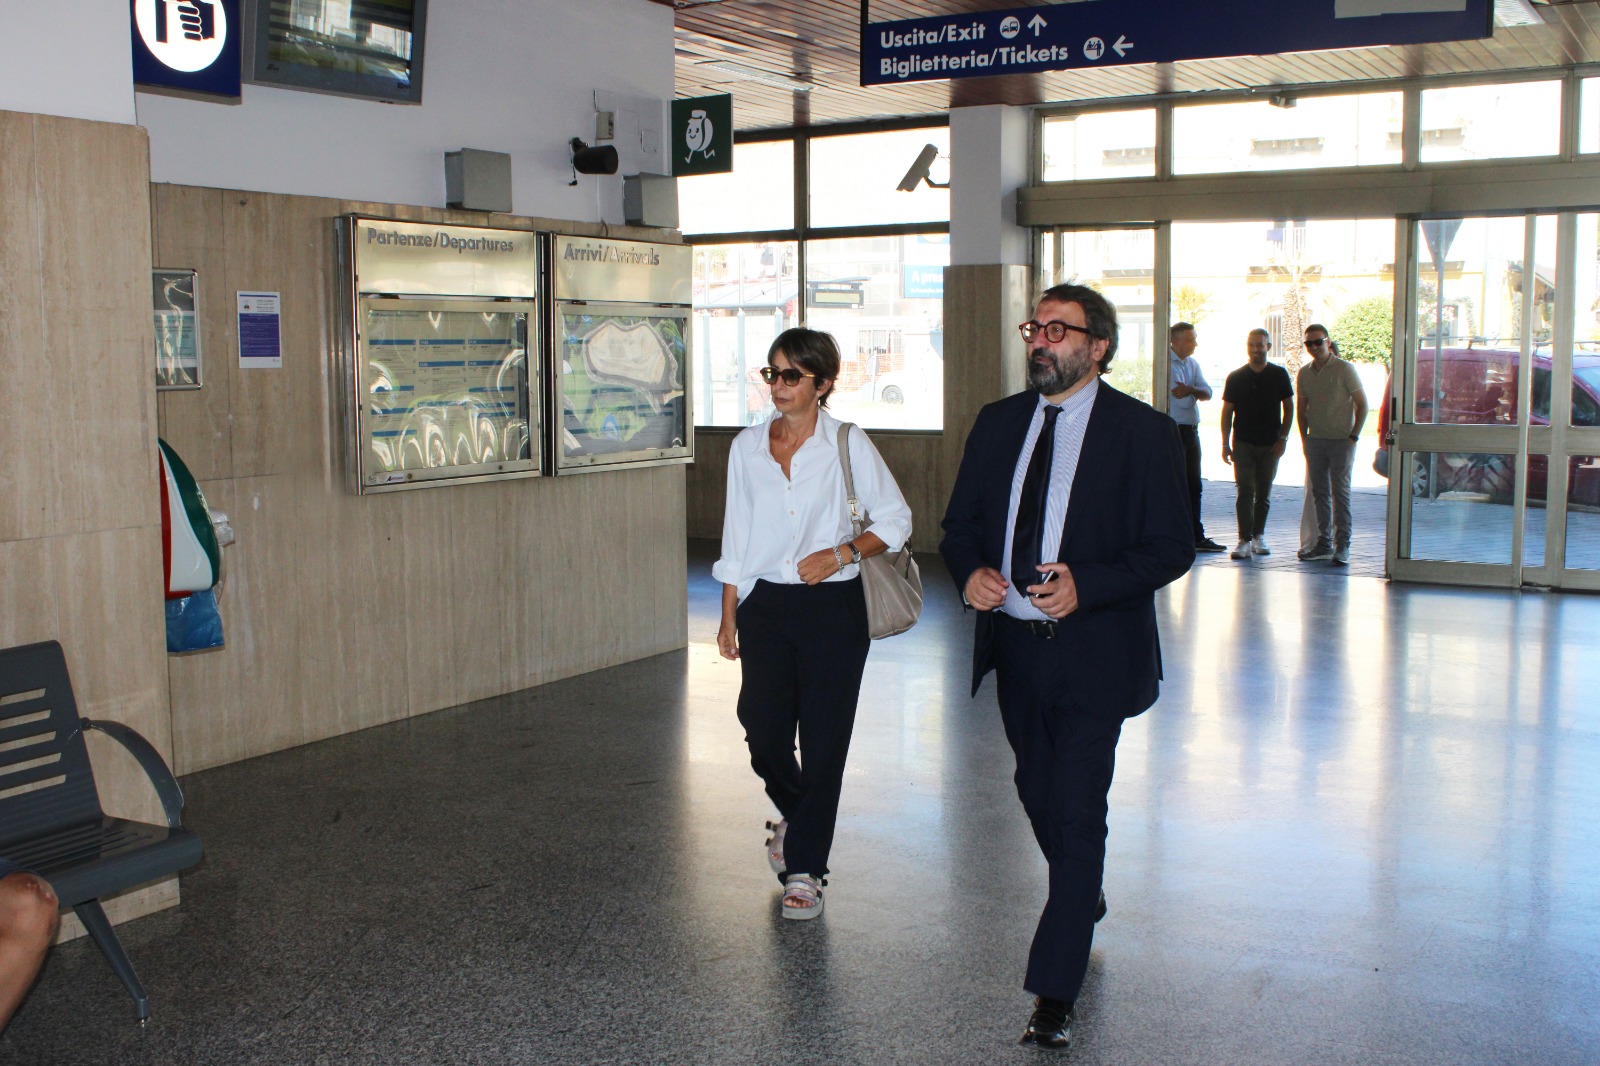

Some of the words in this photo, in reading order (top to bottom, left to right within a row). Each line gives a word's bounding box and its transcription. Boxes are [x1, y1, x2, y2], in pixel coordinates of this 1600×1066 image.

[880, 22, 986, 49] Uscita/Exit
[880, 45, 1068, 78] Biglietteria/Tickets
[367, 227, 513, 253] Partenze/Departures
[564, 242, 660, 266] Arrivi/Arrivals
